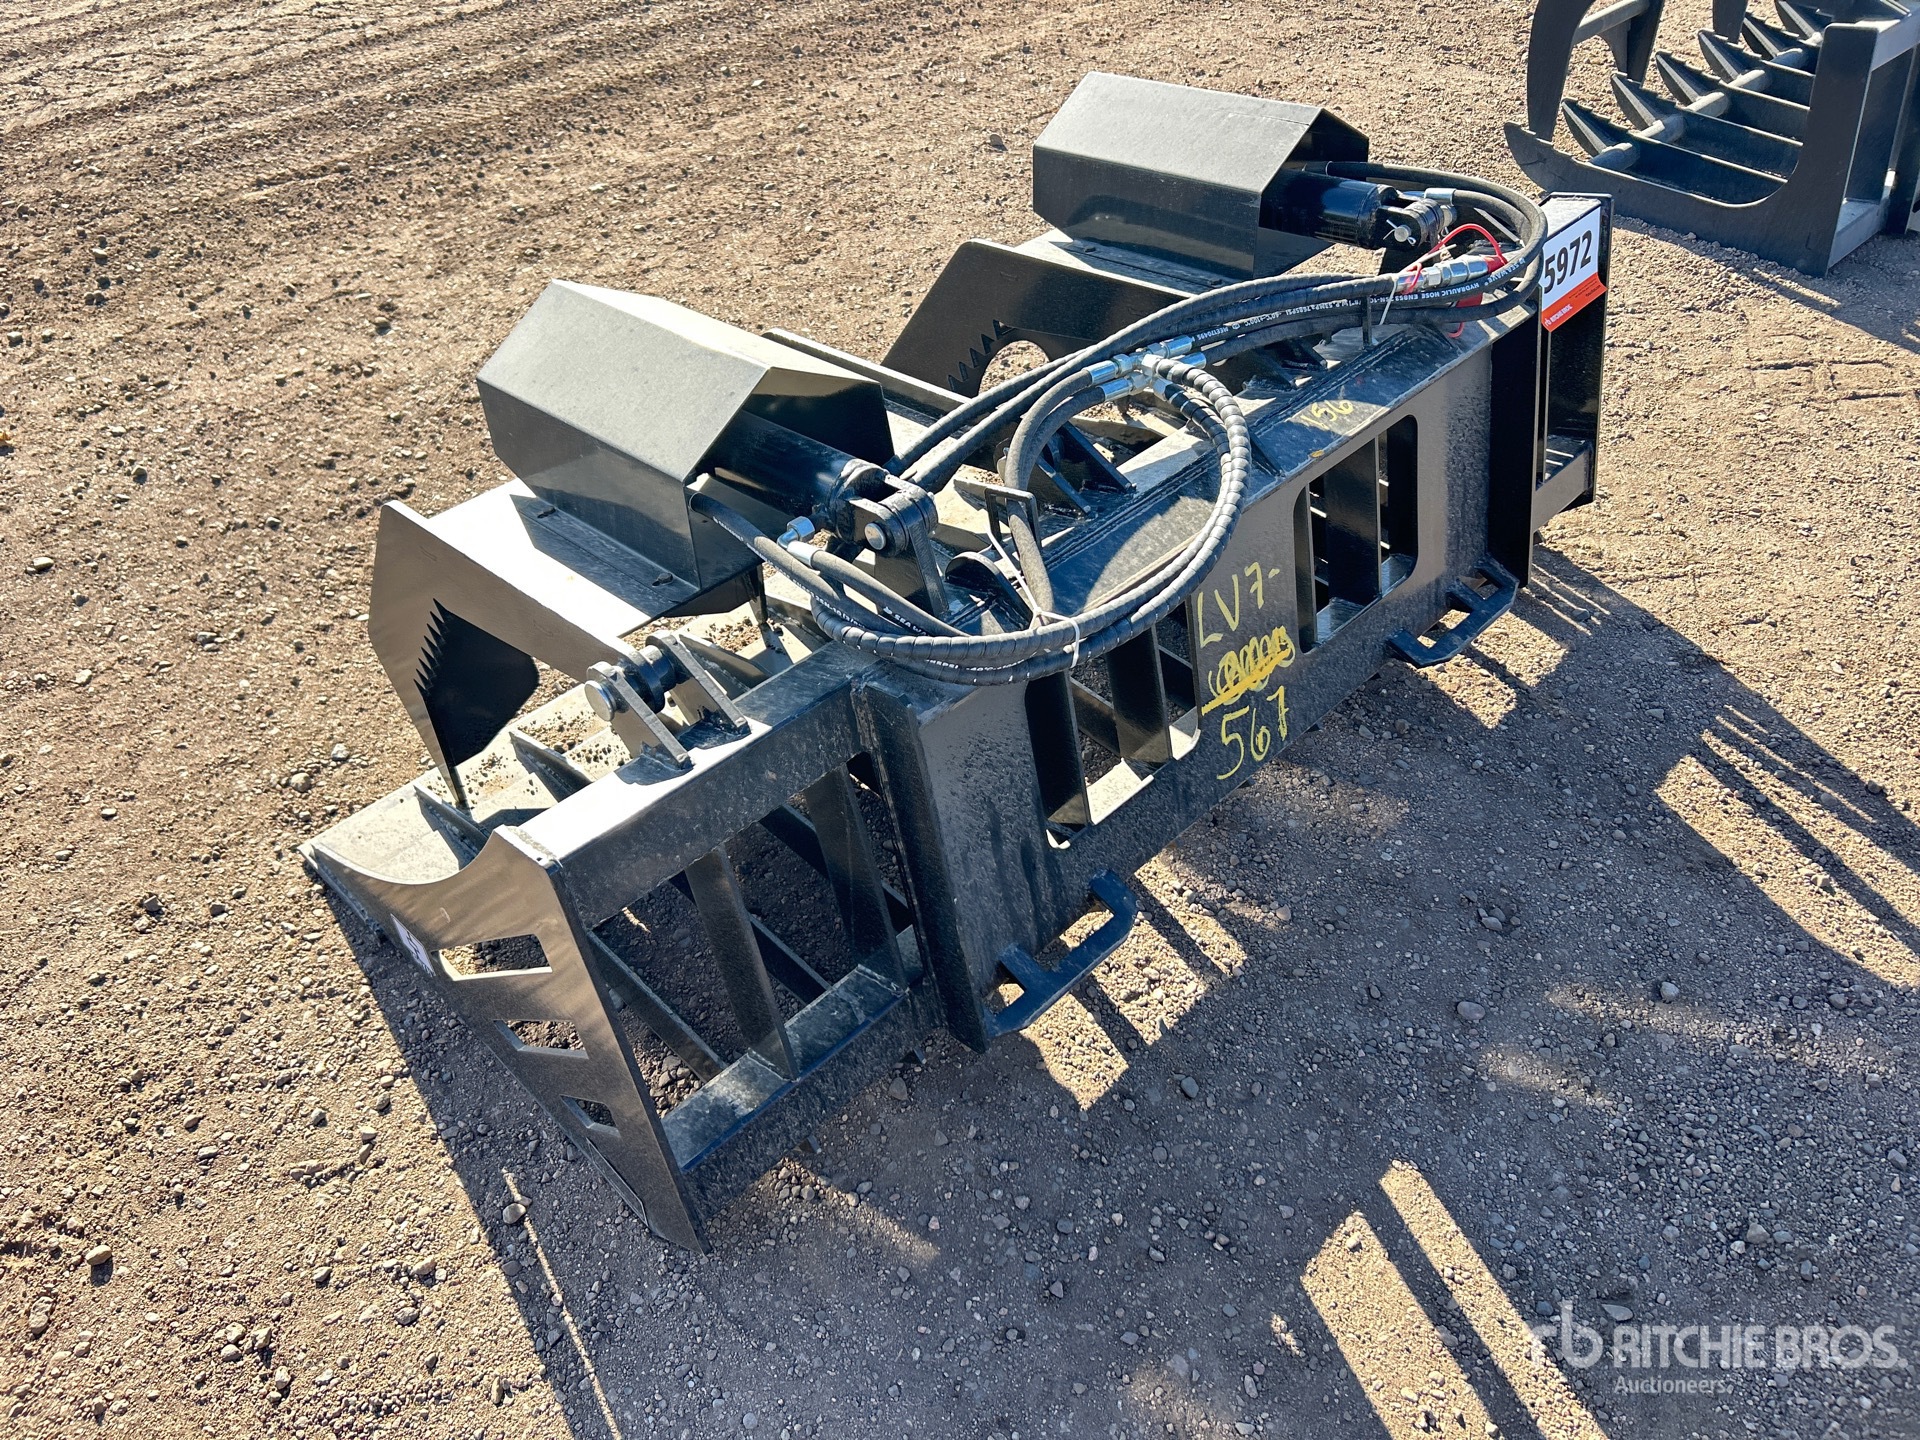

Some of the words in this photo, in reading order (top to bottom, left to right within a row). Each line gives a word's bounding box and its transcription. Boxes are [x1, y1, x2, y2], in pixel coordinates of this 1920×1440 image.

[1544, 230, 1592, 294] 5972
[1421, 291, 1440, 300] HOSE
[1441, 282, 1479, 296] HYDRAULIC
[1216, 685, 1290, 780] 567
